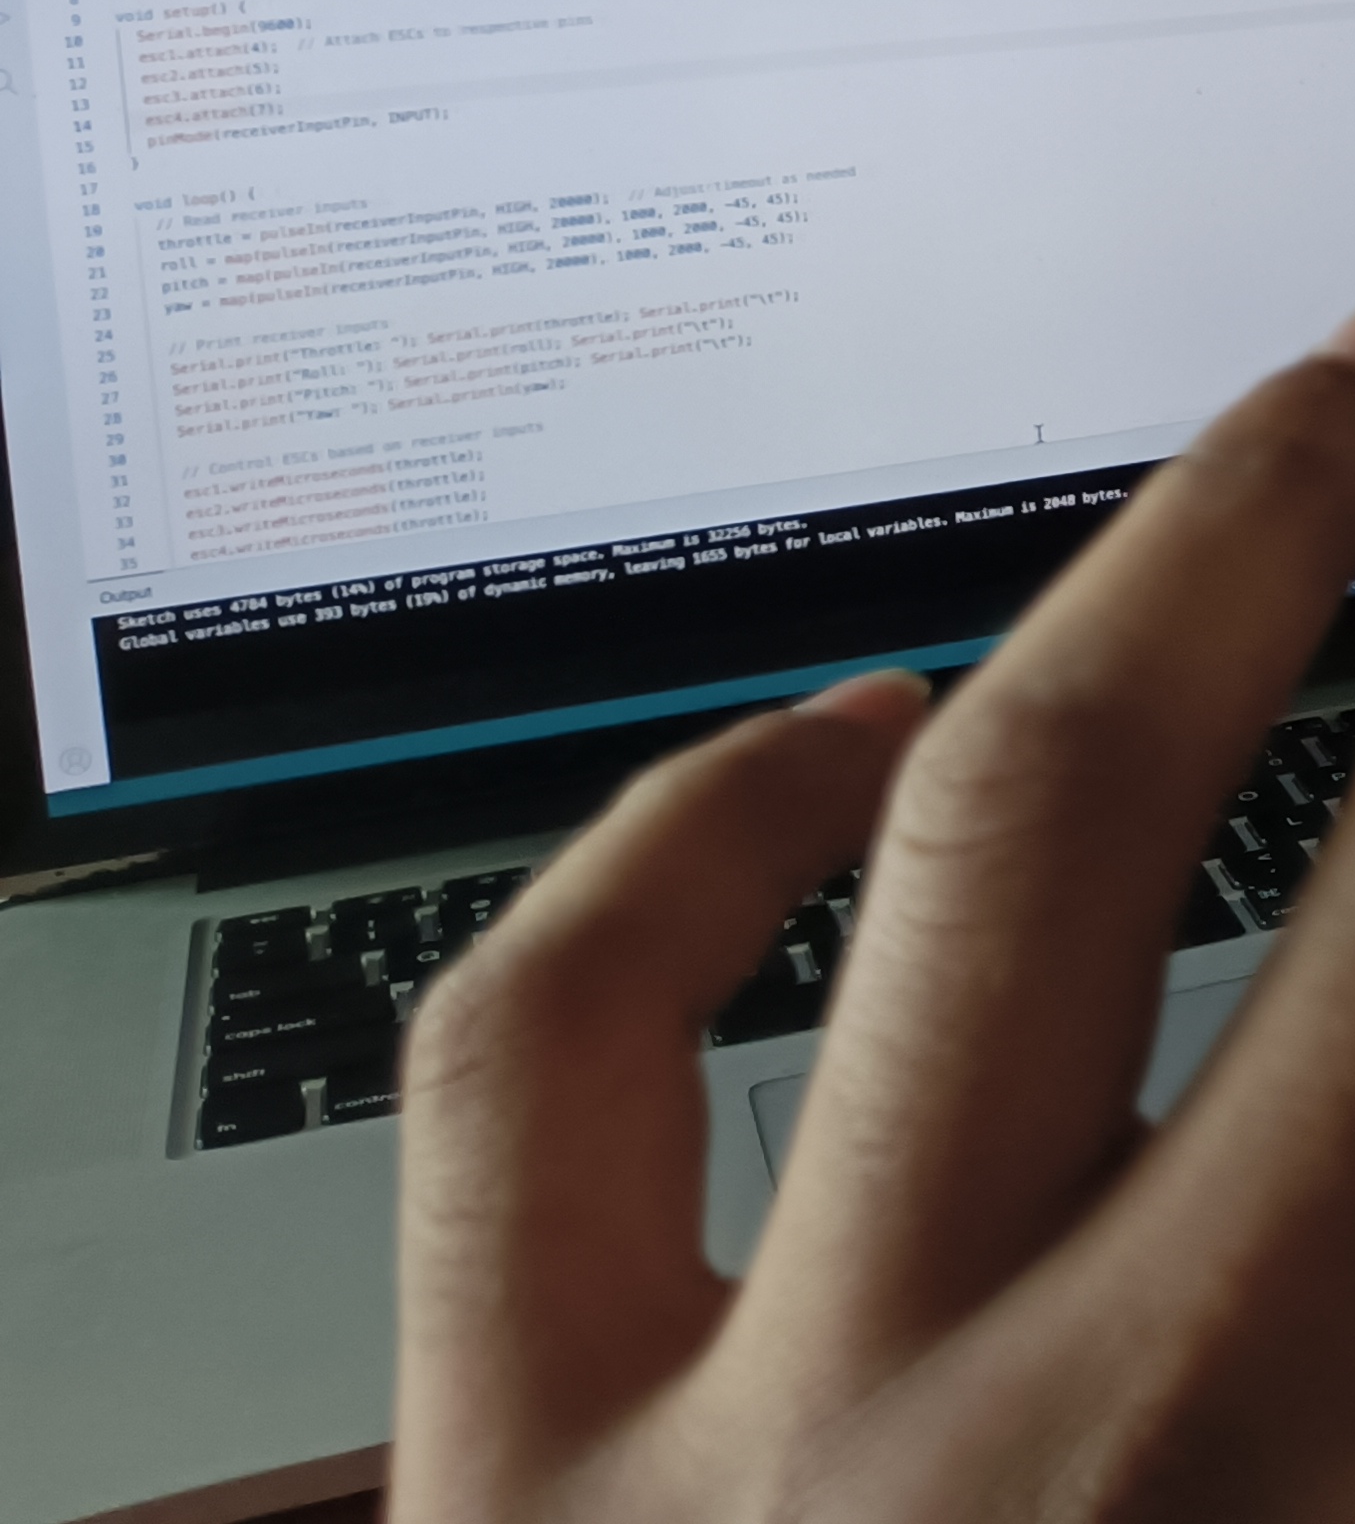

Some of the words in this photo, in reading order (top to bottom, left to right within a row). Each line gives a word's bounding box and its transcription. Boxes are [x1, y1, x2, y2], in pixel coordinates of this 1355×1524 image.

[71, 13, 82, 27] 9
[65, 34, 84, 49] 10
[67, 55, 85, 70] 11
[69, 76, 88, 91] 12
[71, 97, 90, 112] 13
[74, 118, 92, 133] 14
[118, 609, 175, 632] Sketch
[184, 606, 222, 622] uses
[276, 590, 323, 610] bytes
[332, 579, 376, 602] (14%)
[385, 575, 404, 592] of
[412, 568, 475, 591] program
[483, 558, 546, 577] storage
[554, 550, 604, 569] space.
[614, 539, 675, 558] Maximum
[684, 533, 700, 547] is
[708, 524, 751, 544] 32256
[758, 519, 807, 538] bytes.
[119, 630, 175, 652] Global
[185, 618, 269, 642] variables
[278, 613, 306, 628] use
[314, 605, 342, 622] 393
[351, 599, 396, 619] bytes
[406, 588, 449, 611] (19%)
[458, 584, 477, 601] of
[485, 575, 547, 599] dynamic
[555, 568, 614, 586] memory,
[625, 556, 685, 576] leaving
[693, 547, 727, 565] 1655
[734, 542, 777, 561] bytes
[785, 537, 810, 552] for
[819, 527, 859, 546] local
[867, 518, 947, 539] variables.
[956, 507, 1013, 526] Maximum
[1021, 502, 1037, 516] is
[1044, 495, 1076, 513] 2048
[1083, 490, 1129, 508] bytes.
[99, 585, 153, 606] Output
